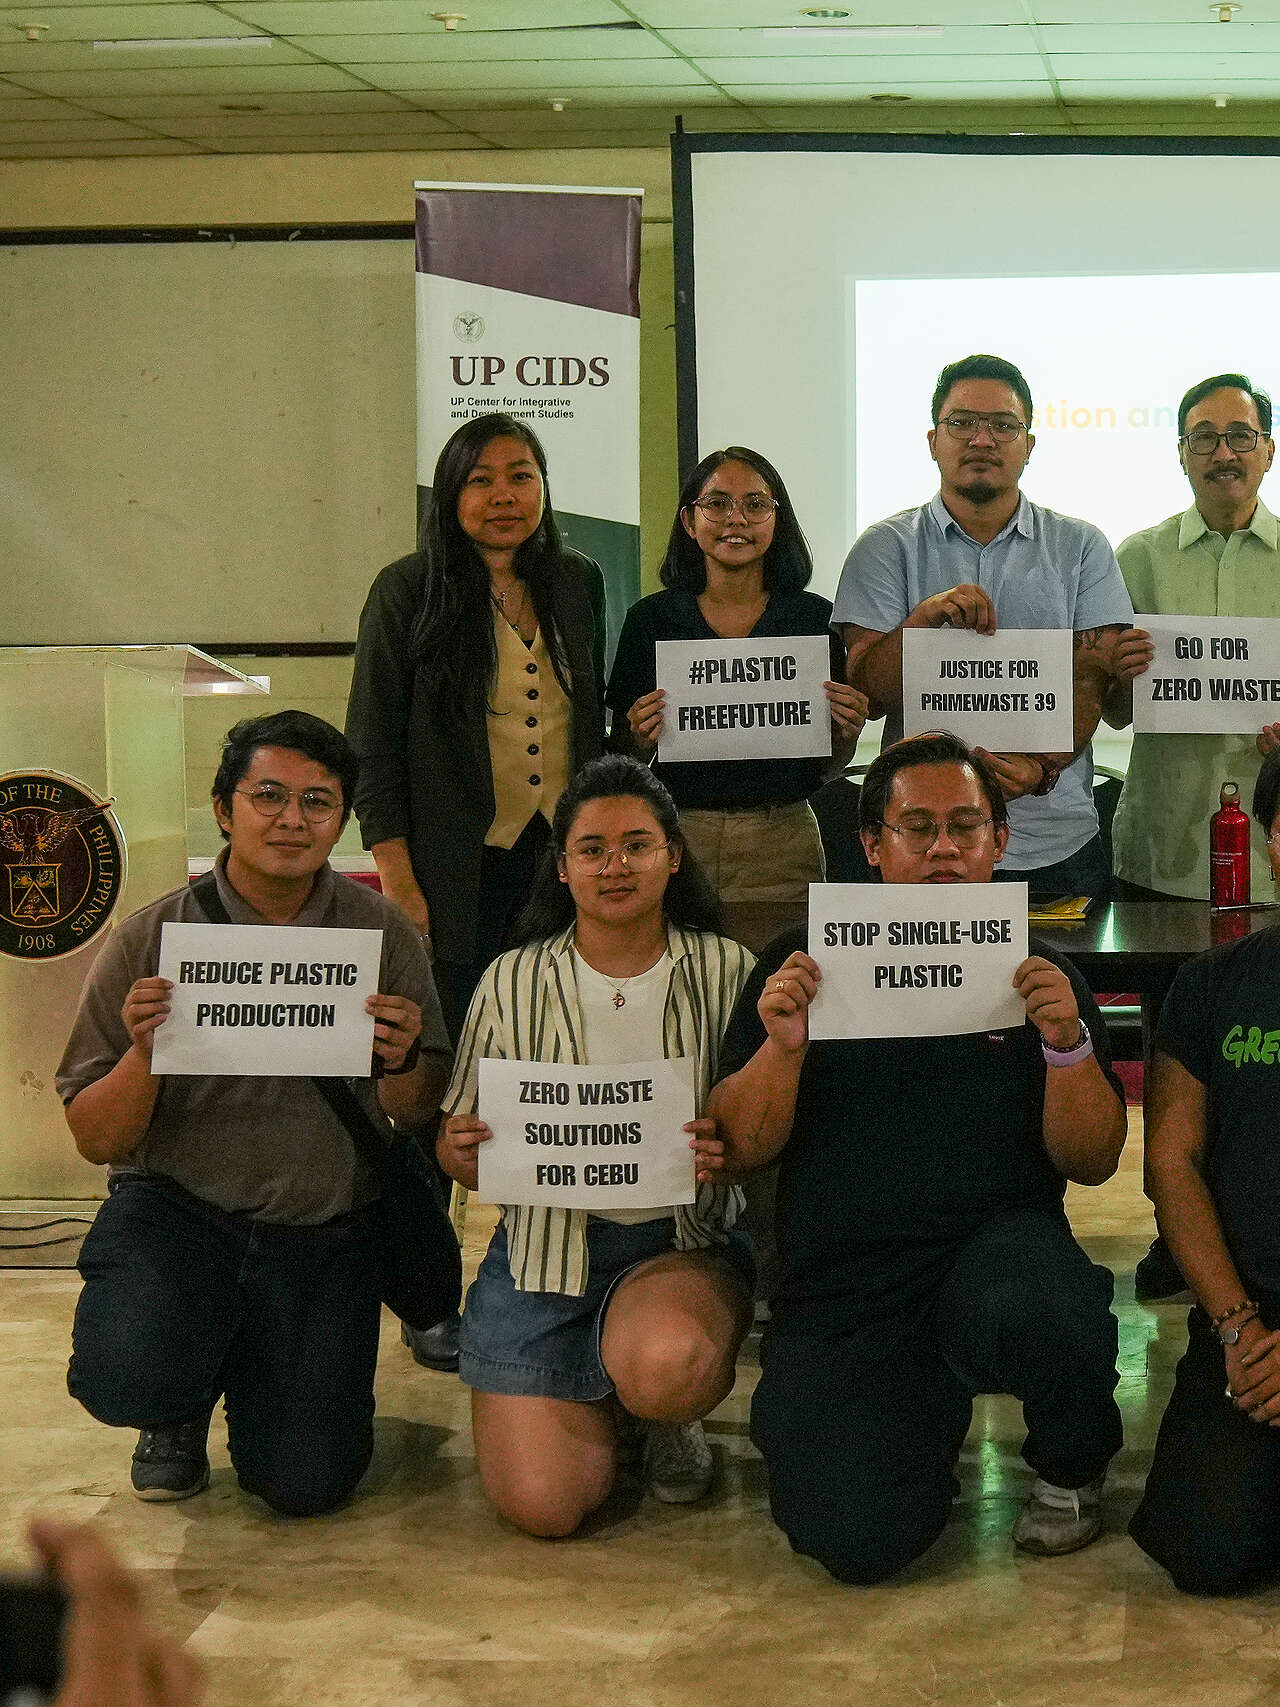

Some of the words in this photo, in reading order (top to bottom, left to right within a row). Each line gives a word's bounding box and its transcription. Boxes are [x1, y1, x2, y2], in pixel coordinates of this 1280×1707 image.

[450, 356, 505, 387] UP
[515, 356, 610, 387] CIDS
[450, 397, 465, 406] UP
[467, 397, 500, 406] Center
[503, 396, 517, 406] for
[519, 397, 571, 408] Integrative
[450, 409, 468, 418] and
[538, 409, 574, 418] Studies
[1128, 405, 1174, 428] an
[1175, 637, 1203, 660] GO
[1210, 637, 1249, 661] FOR
[689, 655, 796, 685] #PLASTIC
[939, 660, 1003, 679] JUSTICE
[1008, 660, 1039, 679] FOR
[921, 693, 1029, 712] PRIMEWASTE
[1034, 692, 1056, 711] 39
[1152, 678, 1202, 702] ZERO
[678, 700, 811, 731] FREEFUTURE
[22, 783, 63, 804] THE
[71, 825, 114, 936] PHILIPPINES
[17, 934, 56, 951] 1908
[824, 921, 880, 947] STOP
[887, 919, 1012, 946] SINGLE-USE
[180, 961, 263, 984] REDUCE
[269, 962, 358, 986] PLASTIC
[874, 964, 963, 988] PLASTIC
[196, 1003, 336, 1027] PRODUCTION
[519, 1081, 570, 1105] ZERO
[577, 1079, 653, 1105] WASTE
[524, 1122, 642, 1147] SOLUTIONS
[536, 1164, 577, 1186] FOR
[584, 1163, 639, 1186] CEBU
